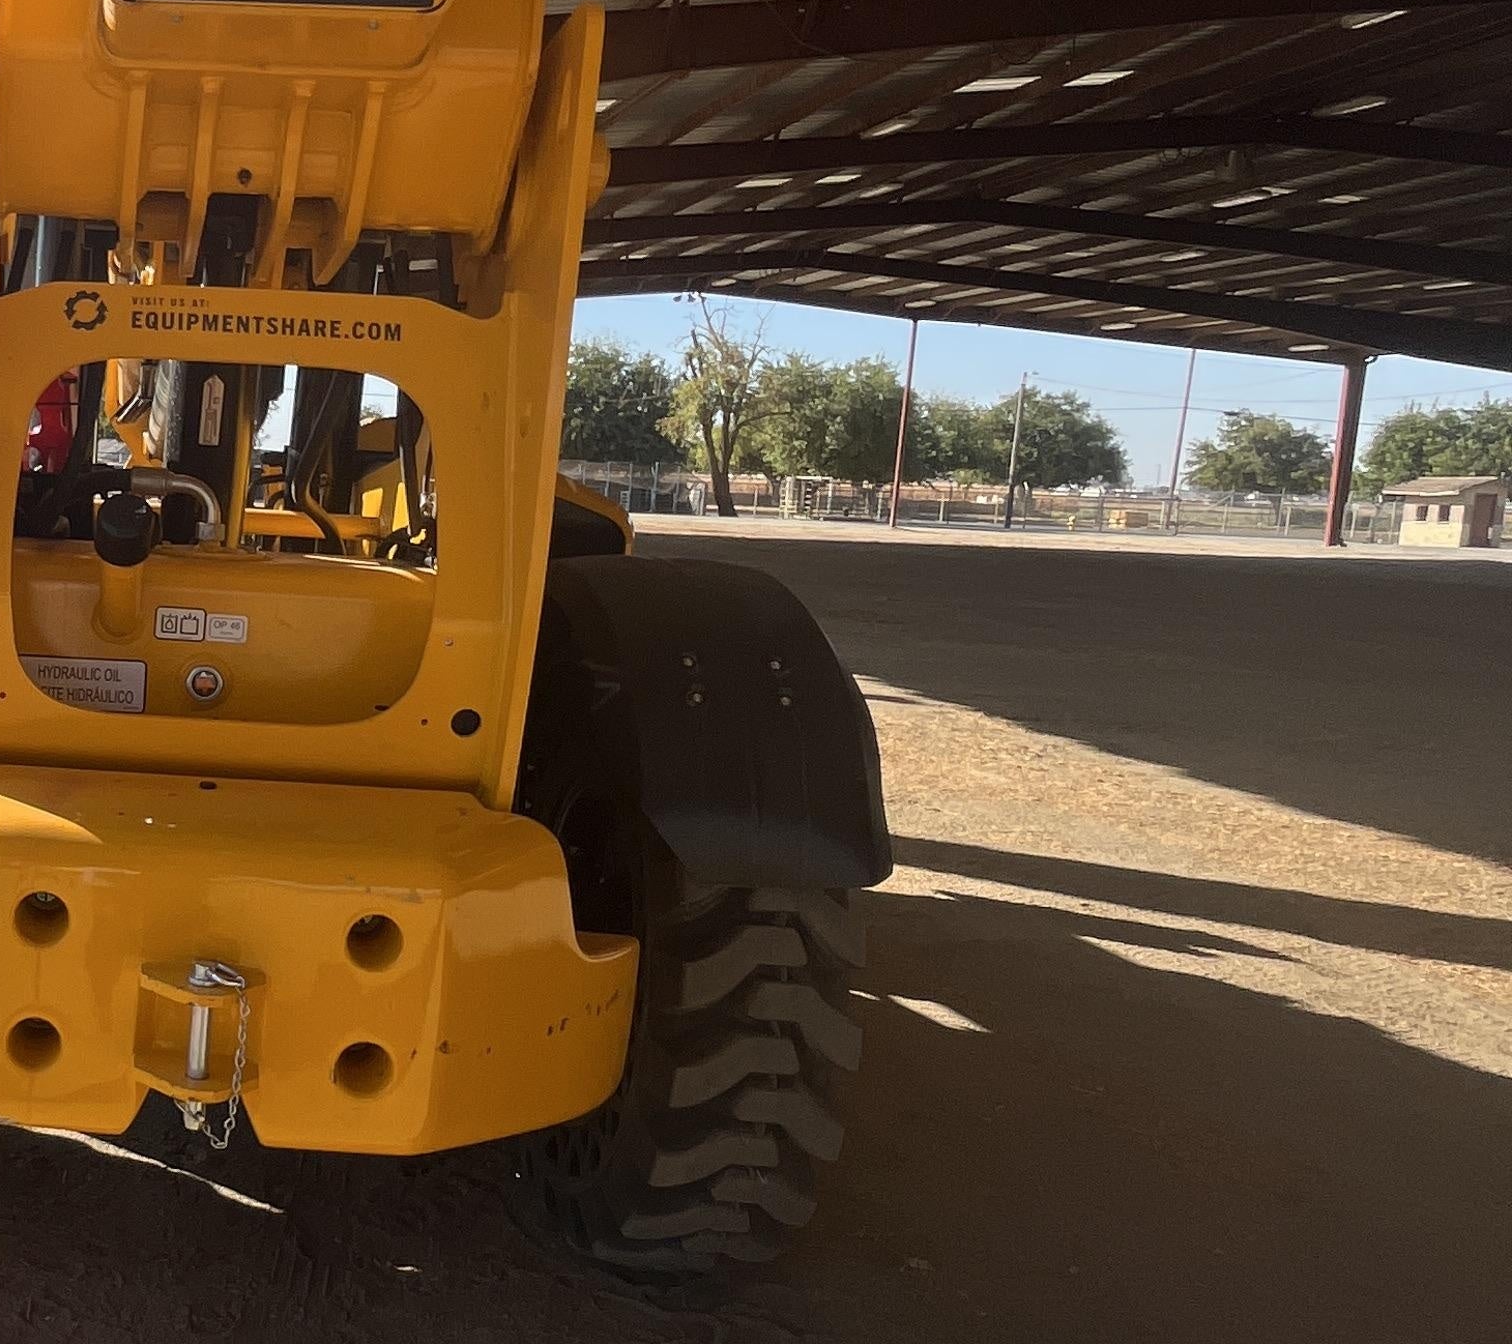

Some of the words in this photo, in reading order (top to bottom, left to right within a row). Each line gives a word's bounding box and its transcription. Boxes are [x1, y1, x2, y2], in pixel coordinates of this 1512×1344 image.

[131, 296, 165, 307] VISIT
[170, 297, 185, 308] US
[130, 310, 402, 343] EQUIPMENTSHARE.COM
[37, 664, 102, 682] HYDRAULIC
[104, 667, 122, 683] OIL
[67, 686, 135, 705] HIDRÁULICO
